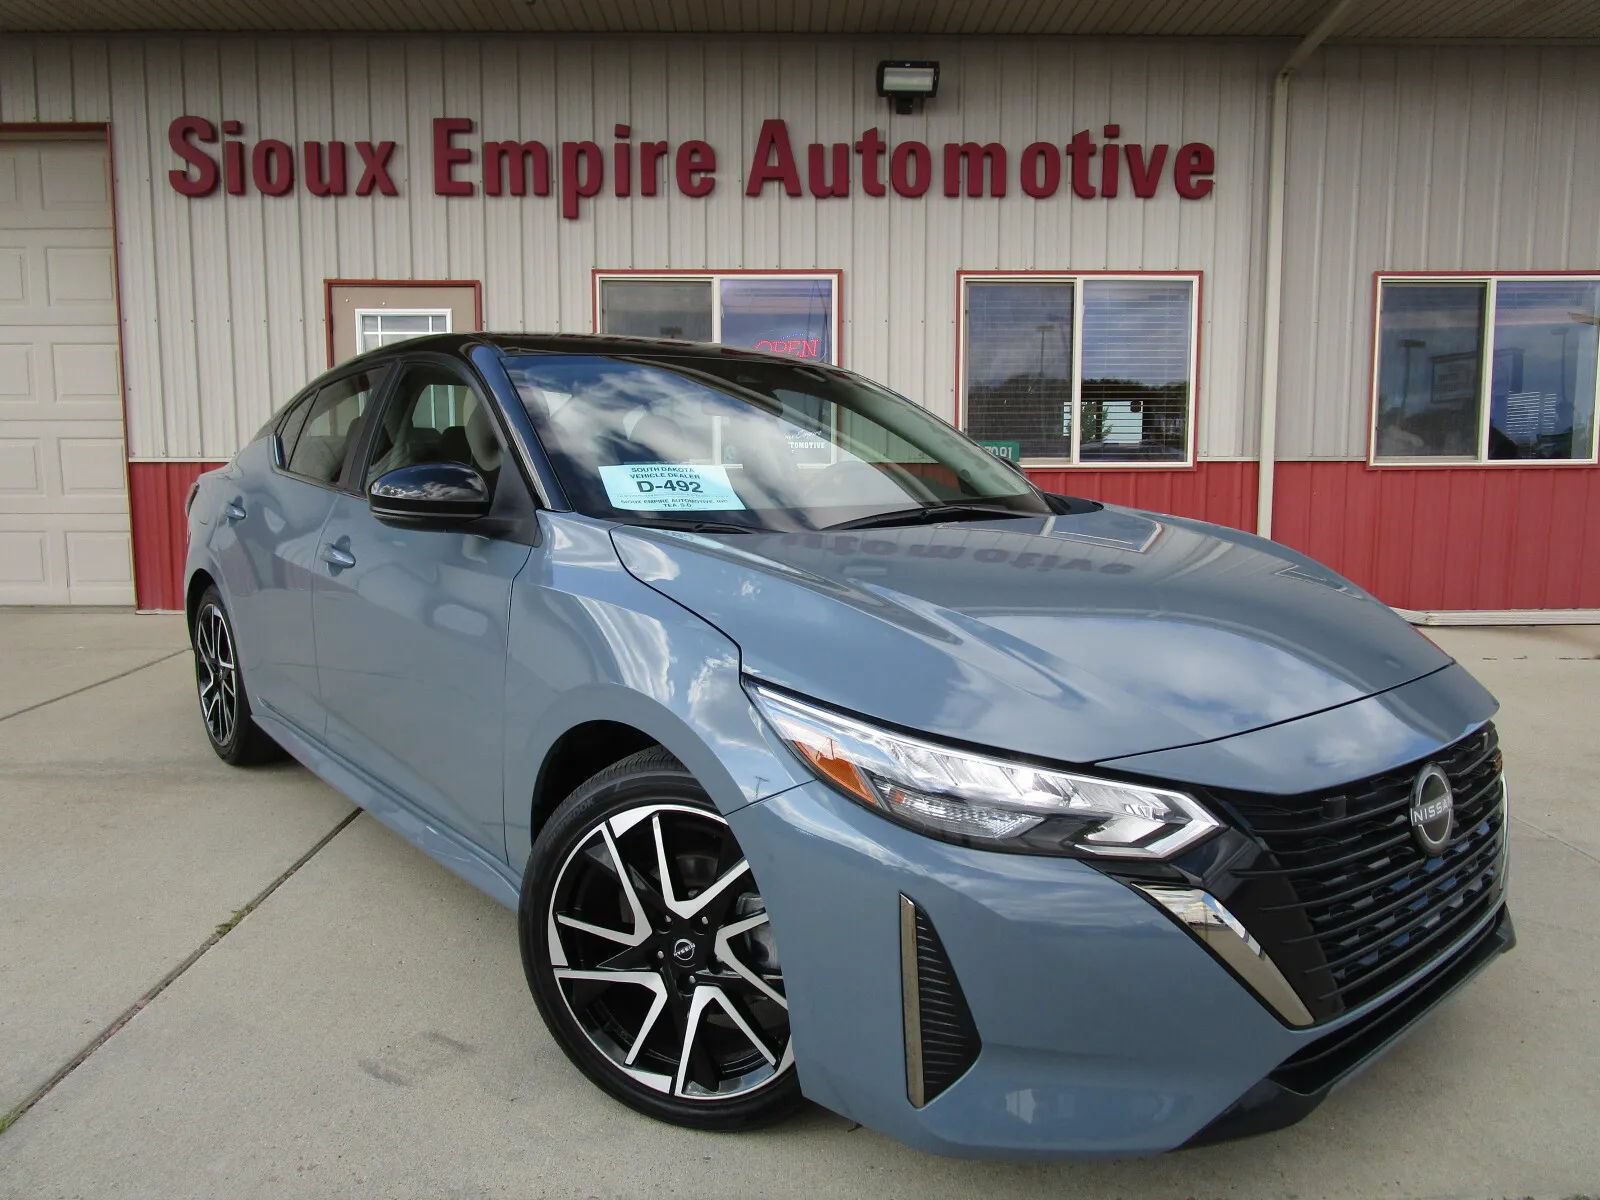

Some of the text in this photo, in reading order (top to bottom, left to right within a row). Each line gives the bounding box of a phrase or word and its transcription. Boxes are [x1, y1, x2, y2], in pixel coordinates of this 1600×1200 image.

[168, 115, 1216, 219] Sioux Empire Automotive
[752, 338, 819, 358] OPEN
[788, 441, 826, 449] TOMOTIVE
[636, 480, 703, 493] D-492
